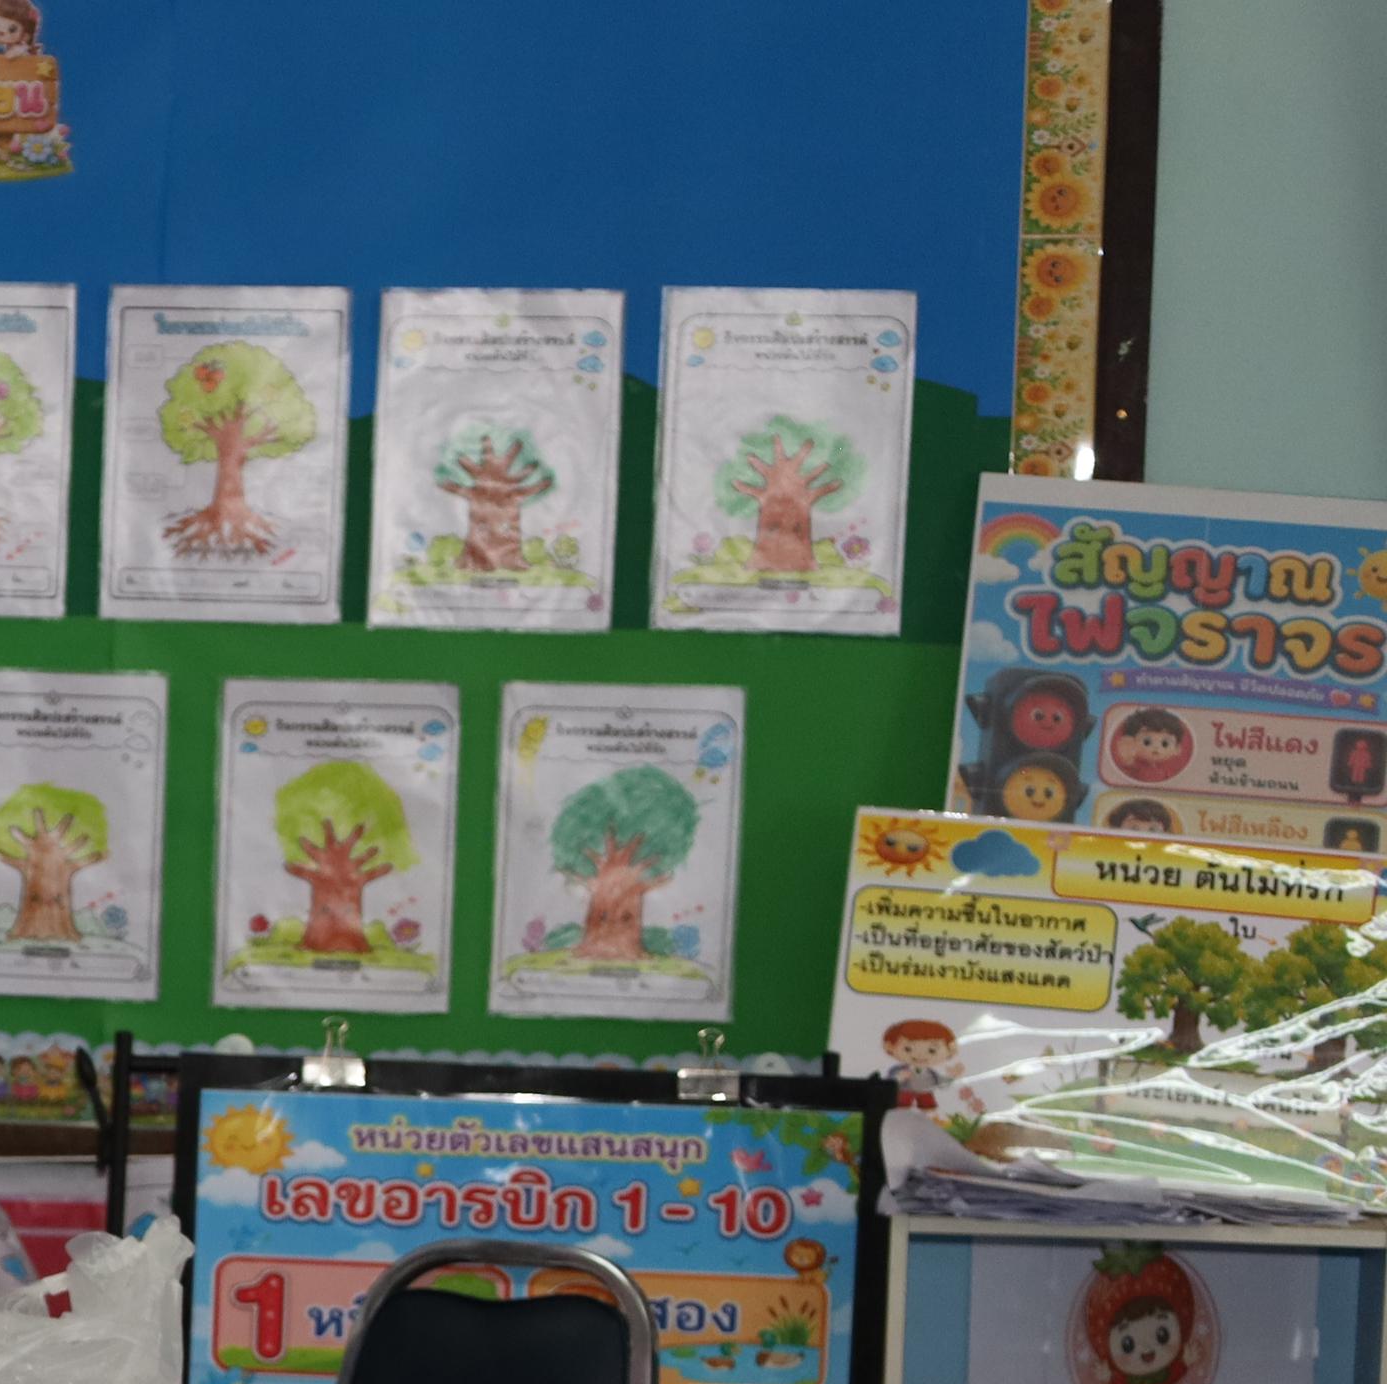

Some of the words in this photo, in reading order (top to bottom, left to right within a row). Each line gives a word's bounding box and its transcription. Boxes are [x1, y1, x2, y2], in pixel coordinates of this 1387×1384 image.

[1052, 520, 1336, 609] สัญญาณ
[1013, 589, 1386, 676] ไฟจราจร
[1211, 721, 1319, 756] ไฟสีแดง
[1209, 753, 1248, 772] หยุด
[1197, 810, 1309, 842] ไฟสีเหลือง
[1095, 856, 1182, 888] หน่วย
[1228, 917, 1257, 941] ใบ
[352, 1117, 705, 1172] หน่วยตัวเลขแสนสนุก
[263, 1167, 596, 1233] เลขอารบิก
[614, 1182, 647, 1232] 1
[661, 1204, 695, 1221] -
[709, 1185, 793, 1239] 10
[233, 1270, 285, 1360] 1
